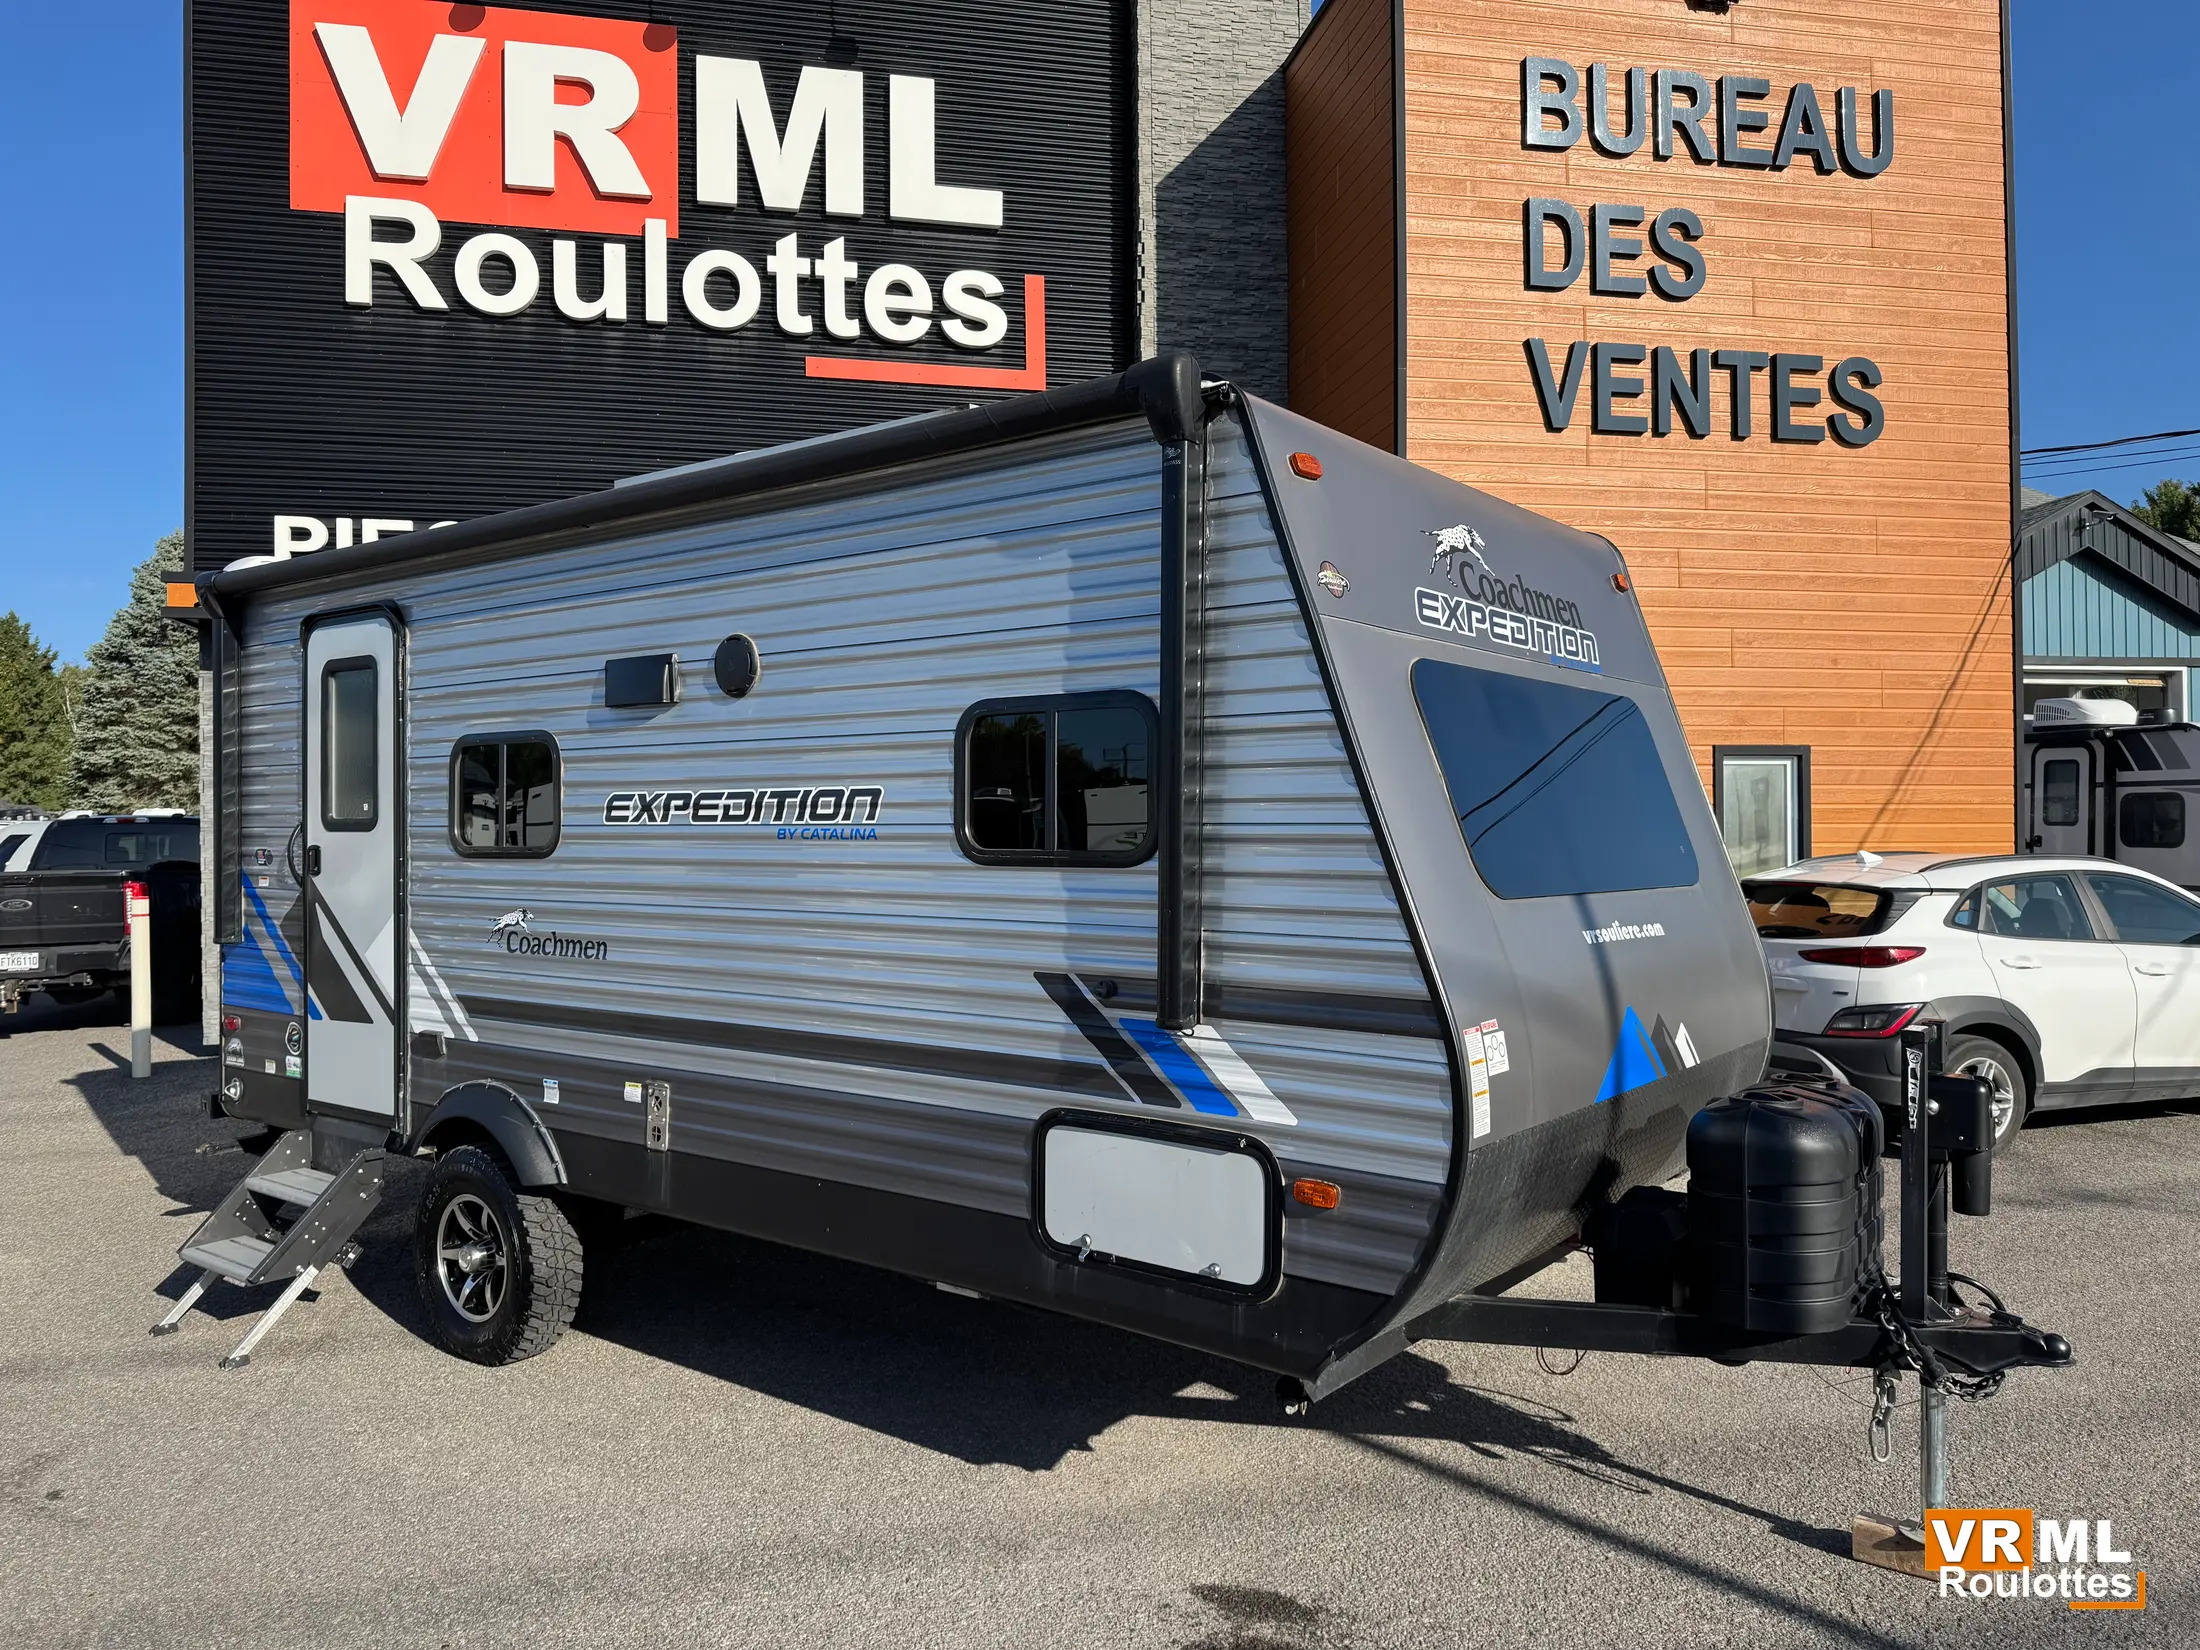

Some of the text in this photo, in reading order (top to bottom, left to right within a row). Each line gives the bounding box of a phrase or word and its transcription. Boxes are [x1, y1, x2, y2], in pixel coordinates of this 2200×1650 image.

[314, 22, 1004, 230] VR ML
[1520, 56, 1895, 180] BUREAU
[345, 194, 1009, 350] Roulottes
[1522, 197, 1708, 303] DES
[1521, 337, 1886, 449] VENTES
[1414, 586, 1600, 665] EXPEDITION
[1459, 560, 1585, 630] Coachmen
[603, 785, 885, 825] EXPEDITION
[776, 827, 878, 841] BY CATALINA
[506, 930, 608, 960] Coachmen
[1582, 920, 1665, 945] vrsouliere.com
